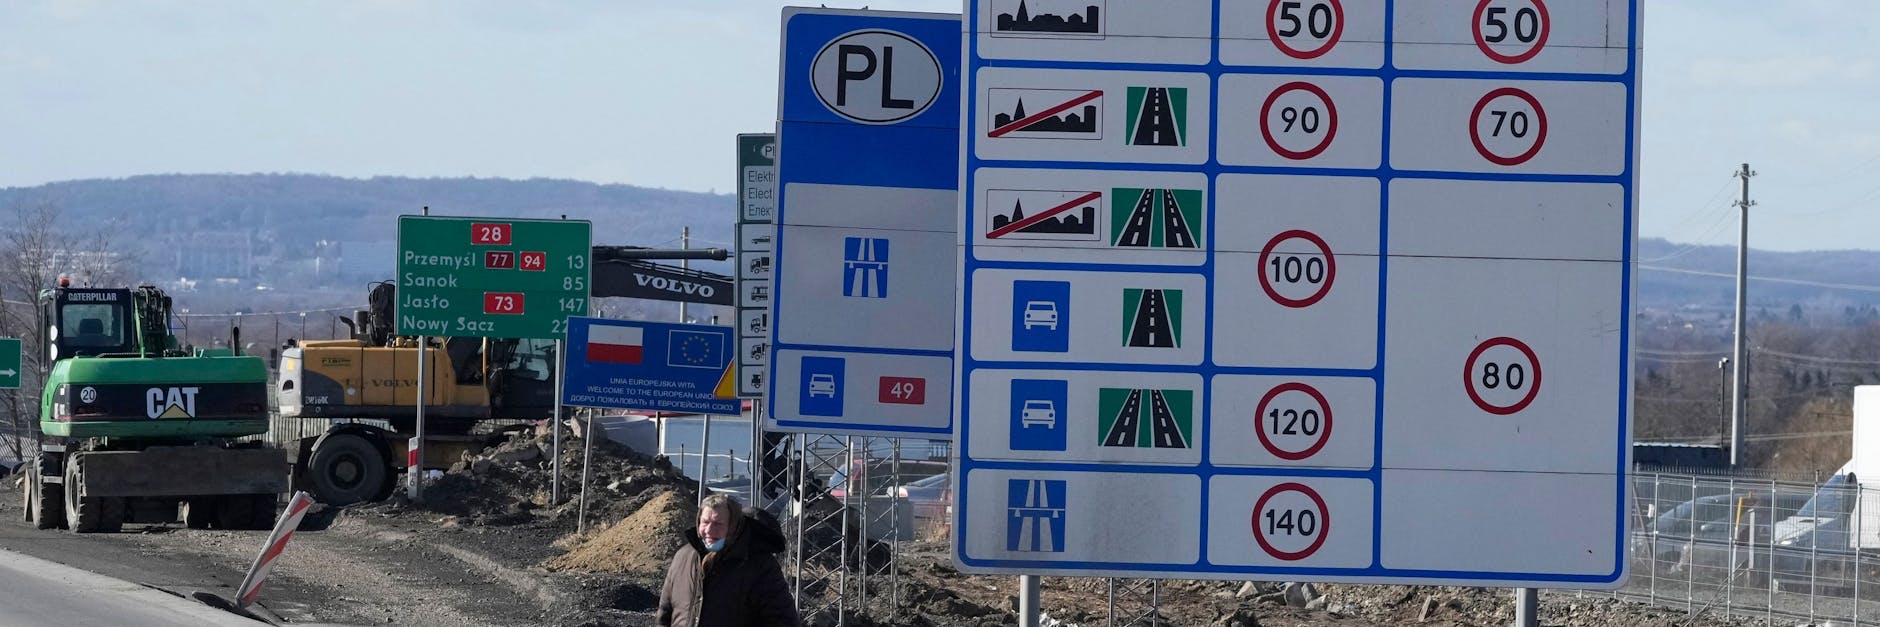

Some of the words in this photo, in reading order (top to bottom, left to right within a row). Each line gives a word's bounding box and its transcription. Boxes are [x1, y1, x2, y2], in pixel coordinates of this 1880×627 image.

[1279, 2, 1332, 39] 50
[1485, 7, 1538, 43] 50
[836, 44, 915, 110] PL
[1282, 107, 1318, 133] 90
[1492, 111, 1527, 137] 70
[748, 204, 772, 216] Елек
[481, 227, 502, 241] 28
[405, 251, 476, 270] Przemyśl
[491, 254, 508, 266] 77
[524, 255, 541, 267] 94
[567, 255, 584, 269] 13
[1270, 255, 1324, 285] 100
[404, 272, 458, 287] Sanok
[563, 277, 584, 290] 85
[633, 272, 715, 298] VOLVO
[68, 292, 117, 301] CATERPILLAR
[403, 293, 449, 309] Jasło
[495, 297, 513, 311] 73
[559, 298, 584, 312] 147
[403, 315, 449, 334] Nowy
[456, 316, 494, 335] Sącz
[370, 379, 419, 387] VOLV
[1483, 363, 1523, 389] 80
[82, 389, 97, 401] 20
[587, 385, 625, 394] WELCOME
[638, 388, 652, 396] THE
[653, 390, 693, 398] EUROPEAN
[890, 382, 914, 400] 49
[146, 387, 199, 419] CAT
[1268, 408, 1320, 438] 120
[1265, 507, 1316, 538] 140
